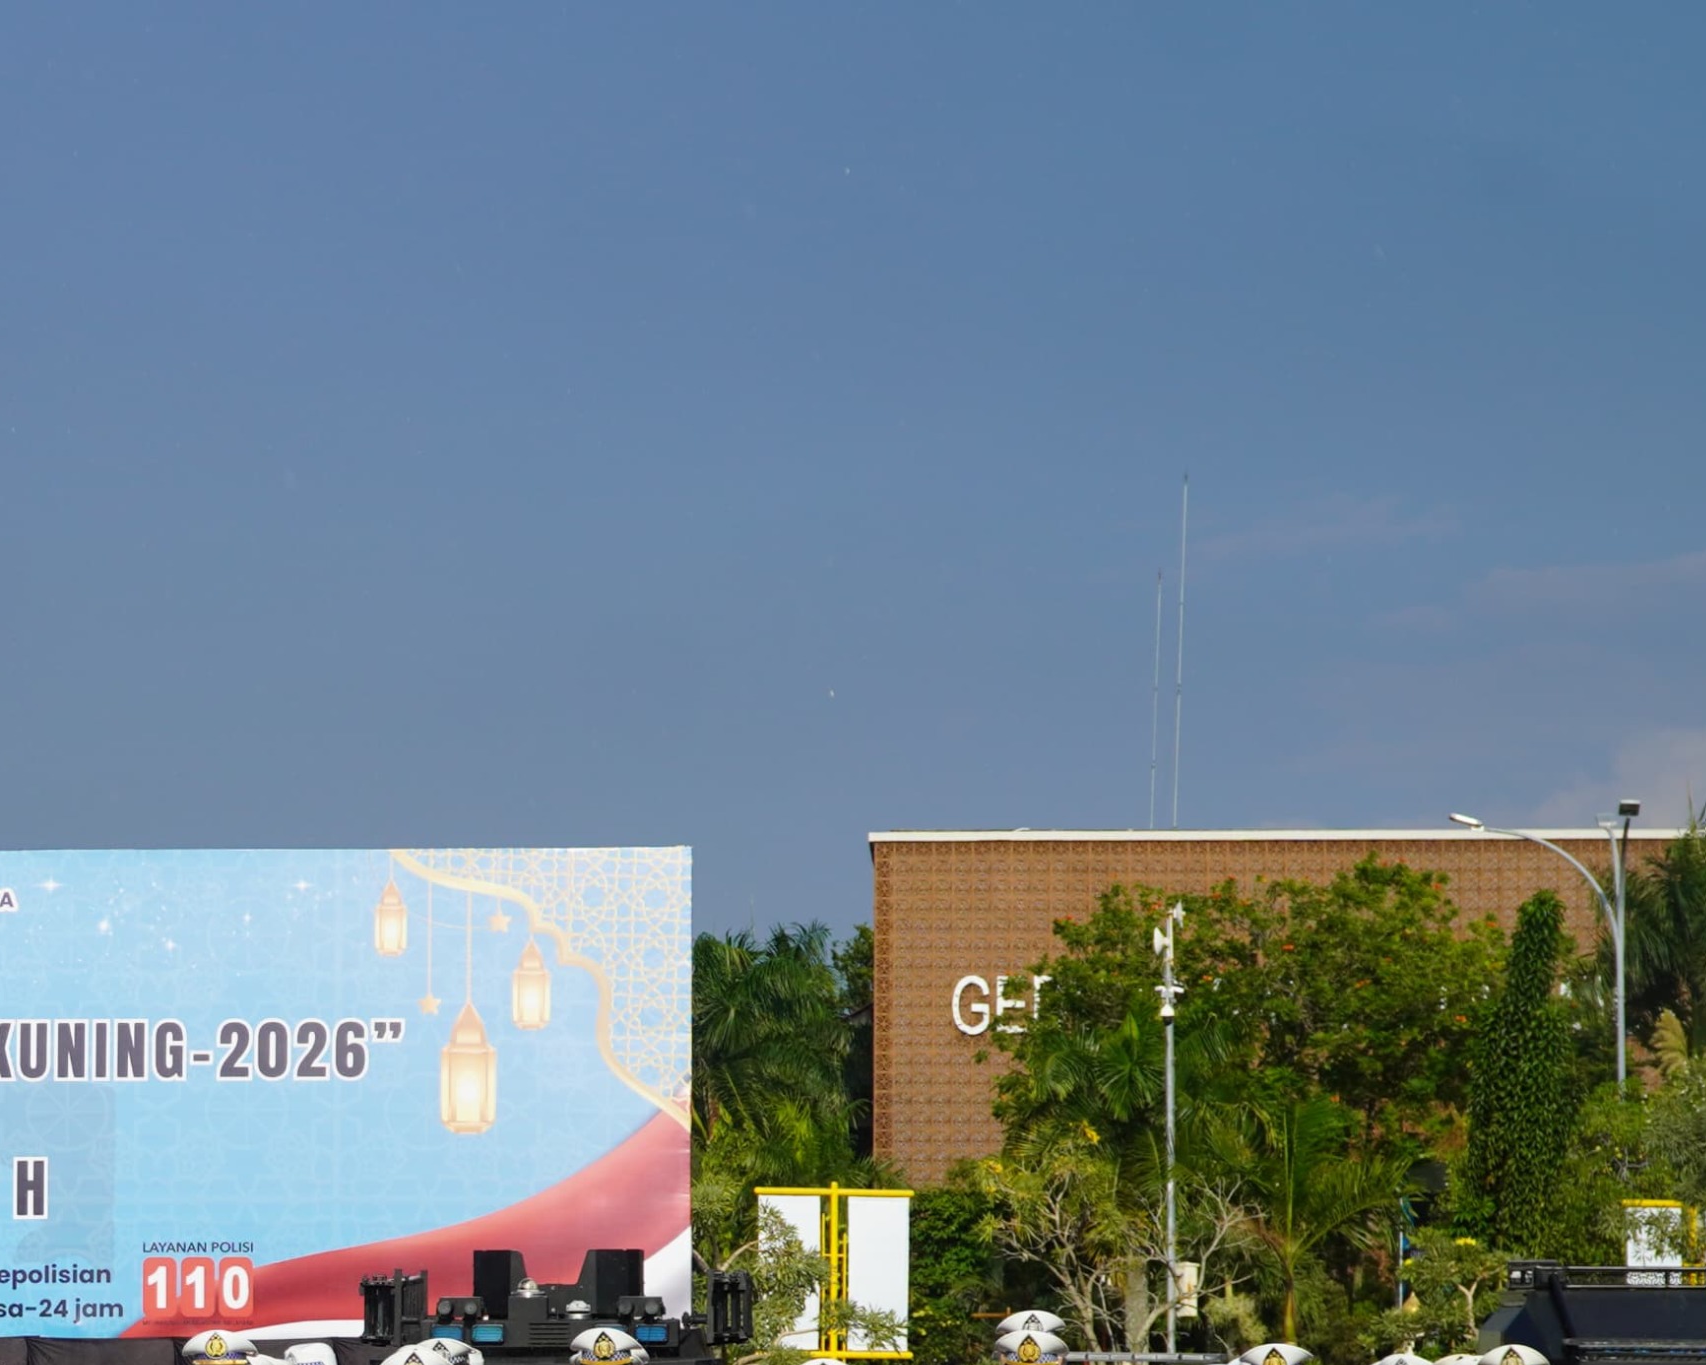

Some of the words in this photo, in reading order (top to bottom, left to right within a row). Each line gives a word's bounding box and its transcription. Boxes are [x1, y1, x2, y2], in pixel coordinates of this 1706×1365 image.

[14, 1159, 46, 1217] H
[142, 1241, 207, 1253] LAYANAN
[211, 1241, 254, 1253] POLISI
[146, 1264, 250, 1310] 110
[73, 1298, 124, 1324] jam
